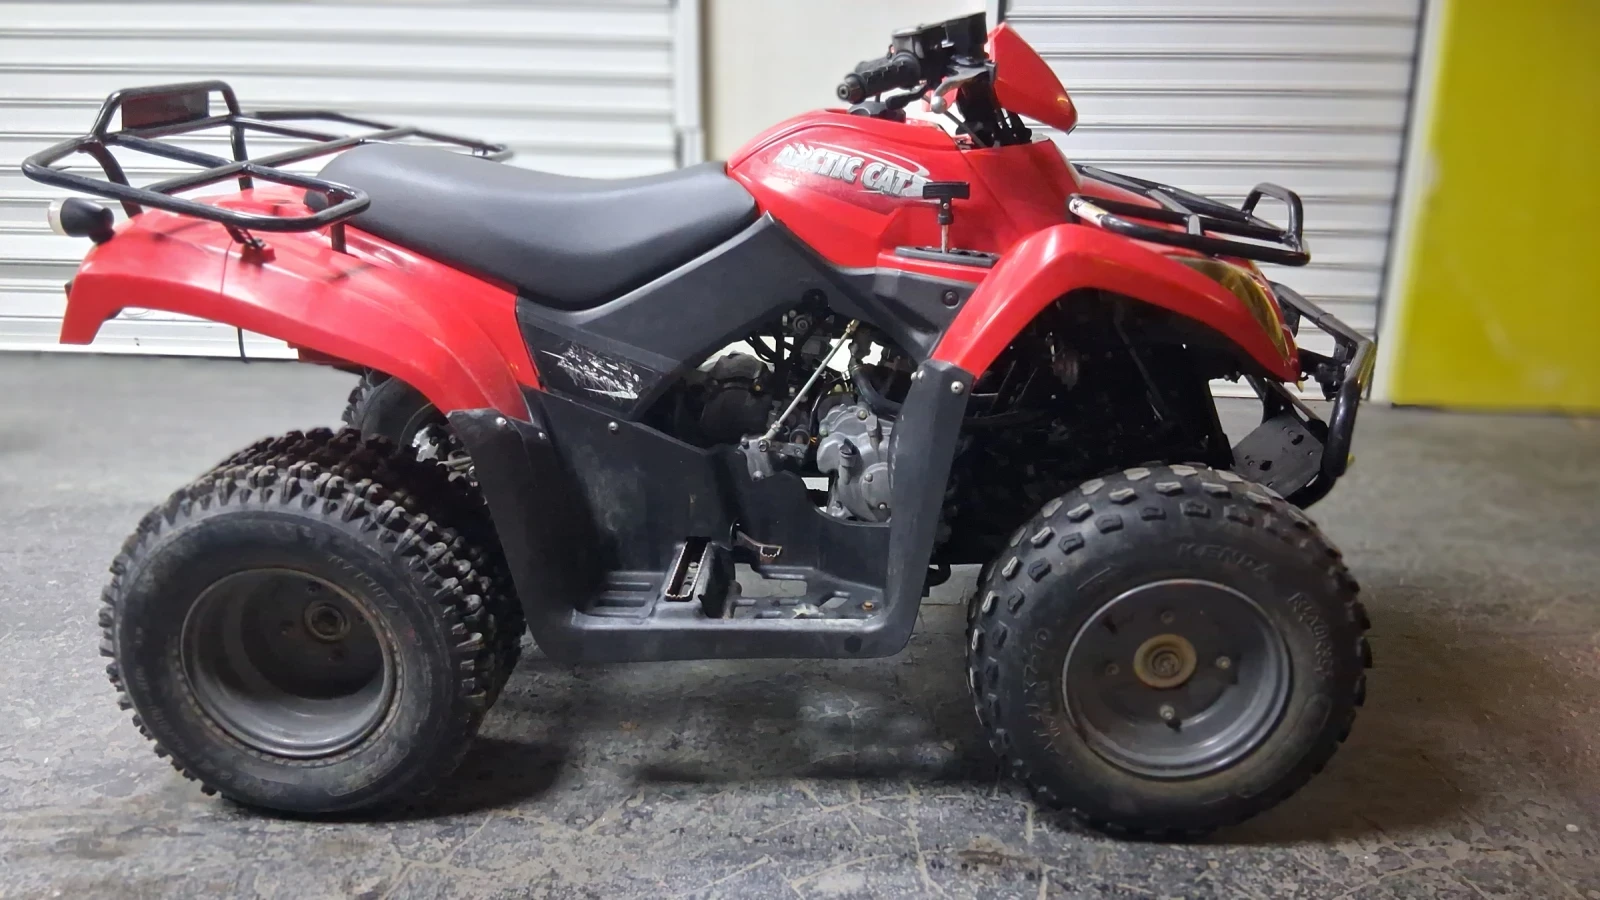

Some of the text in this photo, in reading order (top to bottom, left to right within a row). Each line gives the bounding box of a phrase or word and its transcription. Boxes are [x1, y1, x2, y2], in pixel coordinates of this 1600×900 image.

[773, 143, 914, 197] ARCTIC CAT
[1178, 543, 1269, 581] KENDA
